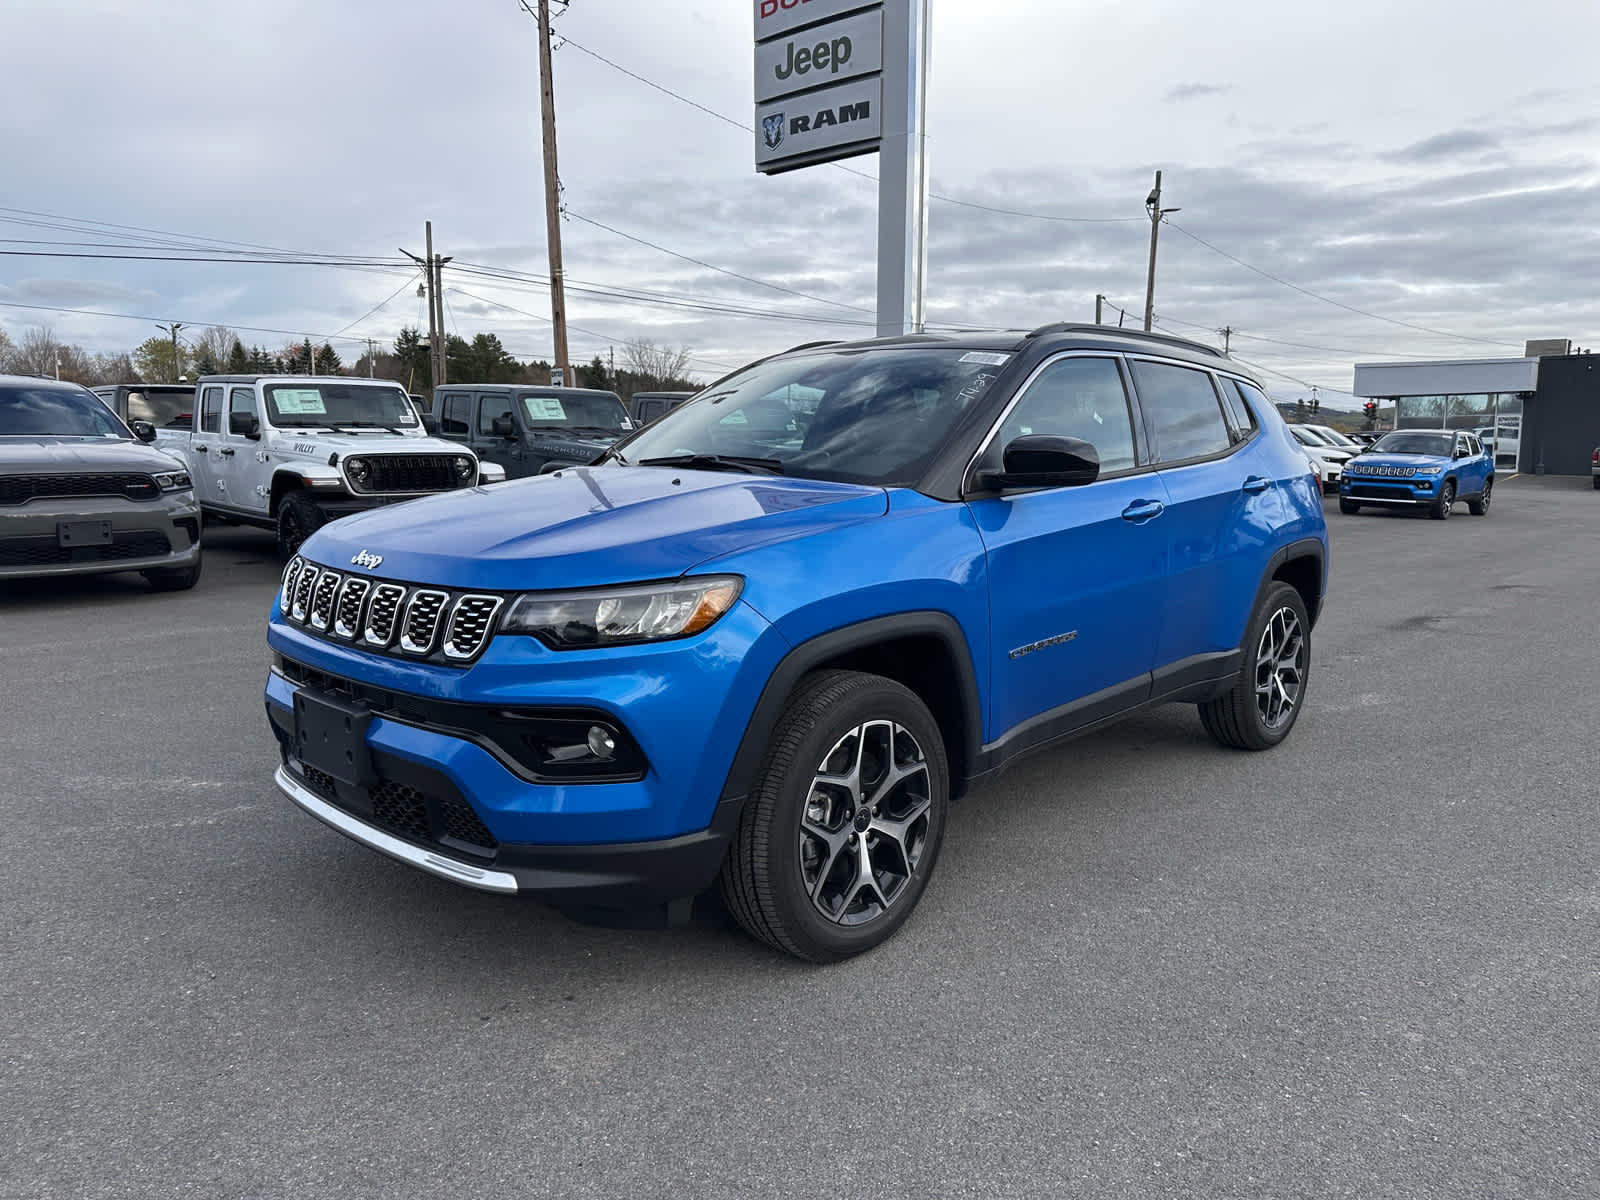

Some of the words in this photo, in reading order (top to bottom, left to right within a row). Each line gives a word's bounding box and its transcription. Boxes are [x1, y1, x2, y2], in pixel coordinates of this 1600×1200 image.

[760, 0, 814, 19] DO
[775, 35, 852, 80] Jeep
[789, 101, 870, 135] RAM
[351, 549, 382, 570] Jeep
